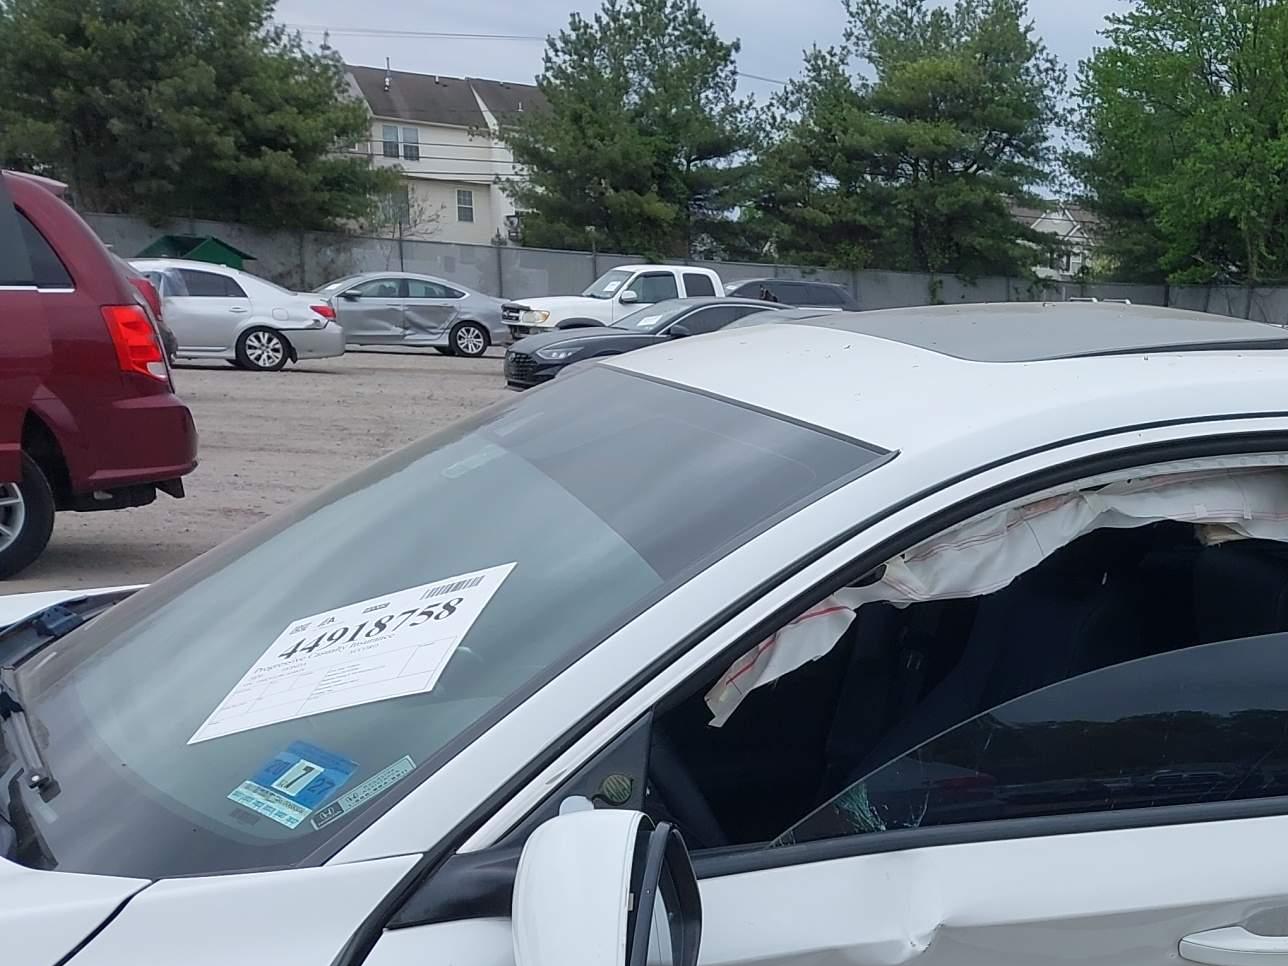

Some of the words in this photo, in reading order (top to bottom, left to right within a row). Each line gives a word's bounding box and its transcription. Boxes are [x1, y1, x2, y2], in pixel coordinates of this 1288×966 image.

[278, 597, 464, 660] 44918758
[285, 765, 316, 789] 7
[307, 777, 336, 795] 27
